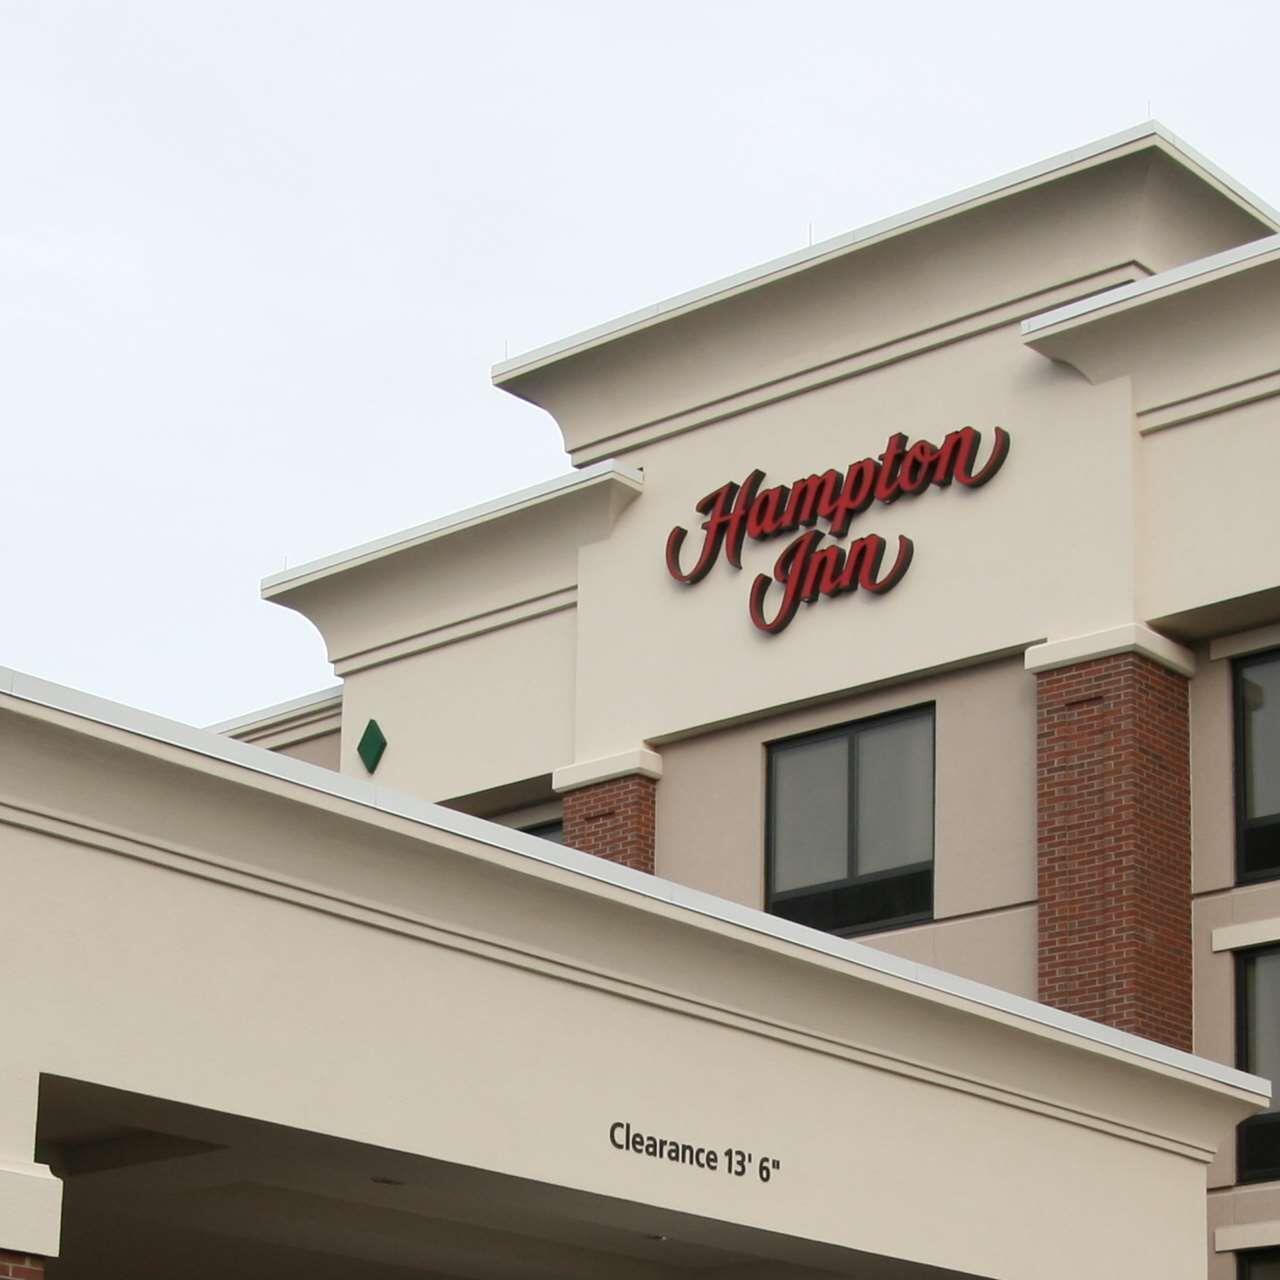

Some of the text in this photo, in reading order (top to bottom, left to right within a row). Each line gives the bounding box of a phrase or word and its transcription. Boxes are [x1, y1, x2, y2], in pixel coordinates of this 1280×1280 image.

[665, 425, 1011, 584] Hampton
[748, 529, 915, 634] Inn
[609, 1121, 780, 1183] Clearance 13' 6"
